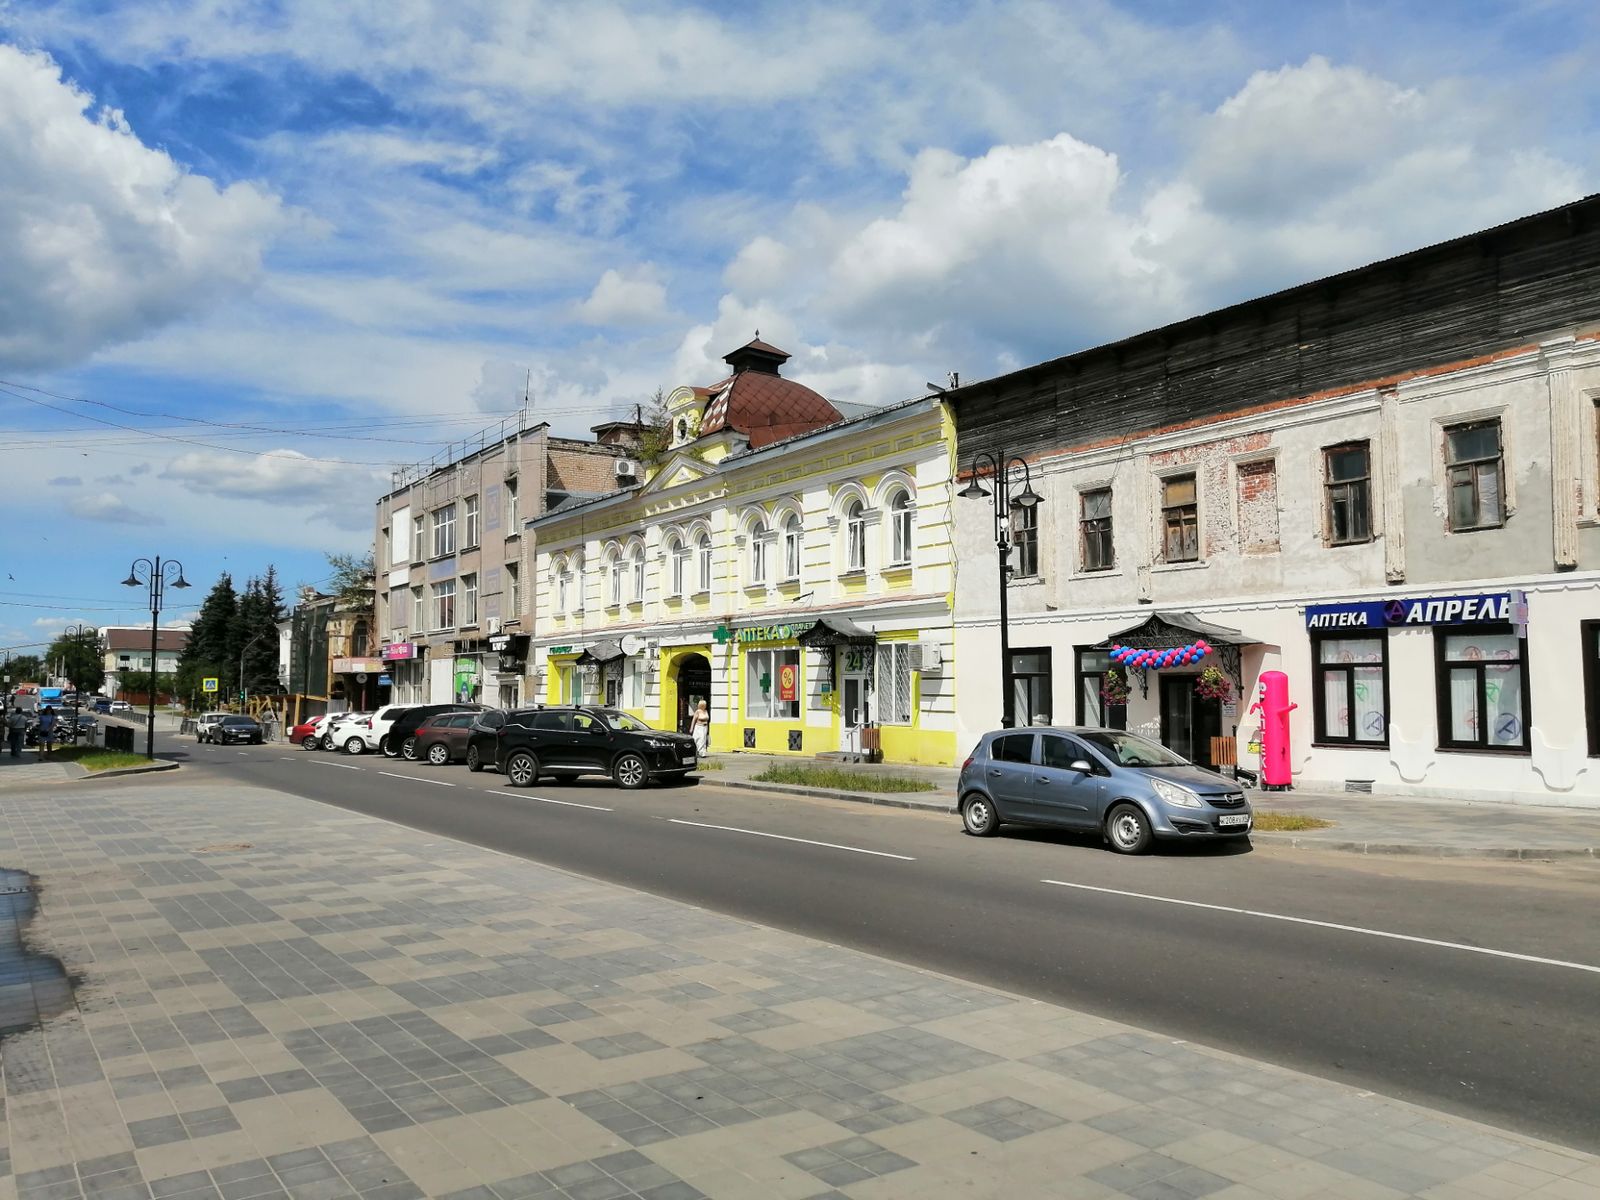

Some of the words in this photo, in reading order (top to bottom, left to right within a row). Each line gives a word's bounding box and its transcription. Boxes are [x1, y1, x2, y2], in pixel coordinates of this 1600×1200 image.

[1308, 611, 1368, 628] АПТЕКА
[1405, 597, 1511, 623] АПРЕЛЬ
[735, 625, 780, 642] АПТЕКА
[845, 652, 864, 672] 24
